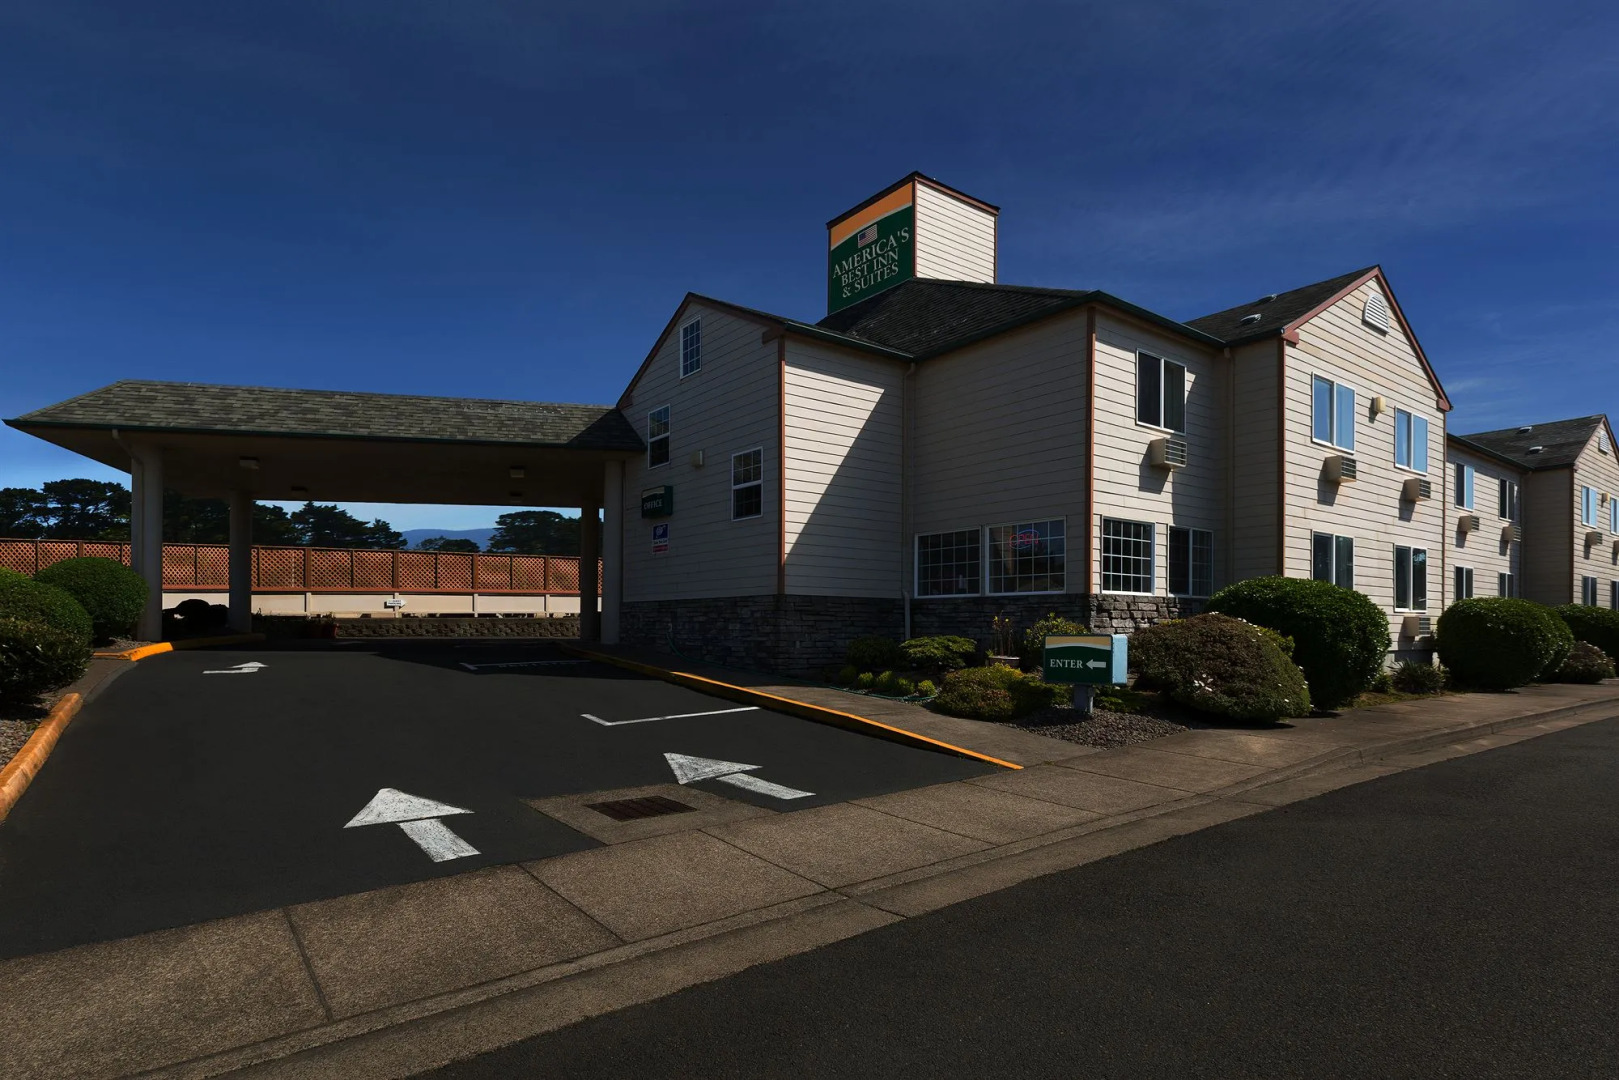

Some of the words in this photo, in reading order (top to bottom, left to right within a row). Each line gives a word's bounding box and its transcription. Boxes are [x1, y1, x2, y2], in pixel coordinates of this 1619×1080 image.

[832, 227, 910, 279] AMERICA'S
[841, 262, 870, 287] BEST
[873, 247, 899, 271] INN
[842, 286, 852, 298] &
[854, 261, 899, 293] SUITES
[643, 499, 663, 510] OFFICE
[1009, 533, 1039, 546] OPEN
[1050, 658, 1083, 669] ENTER
